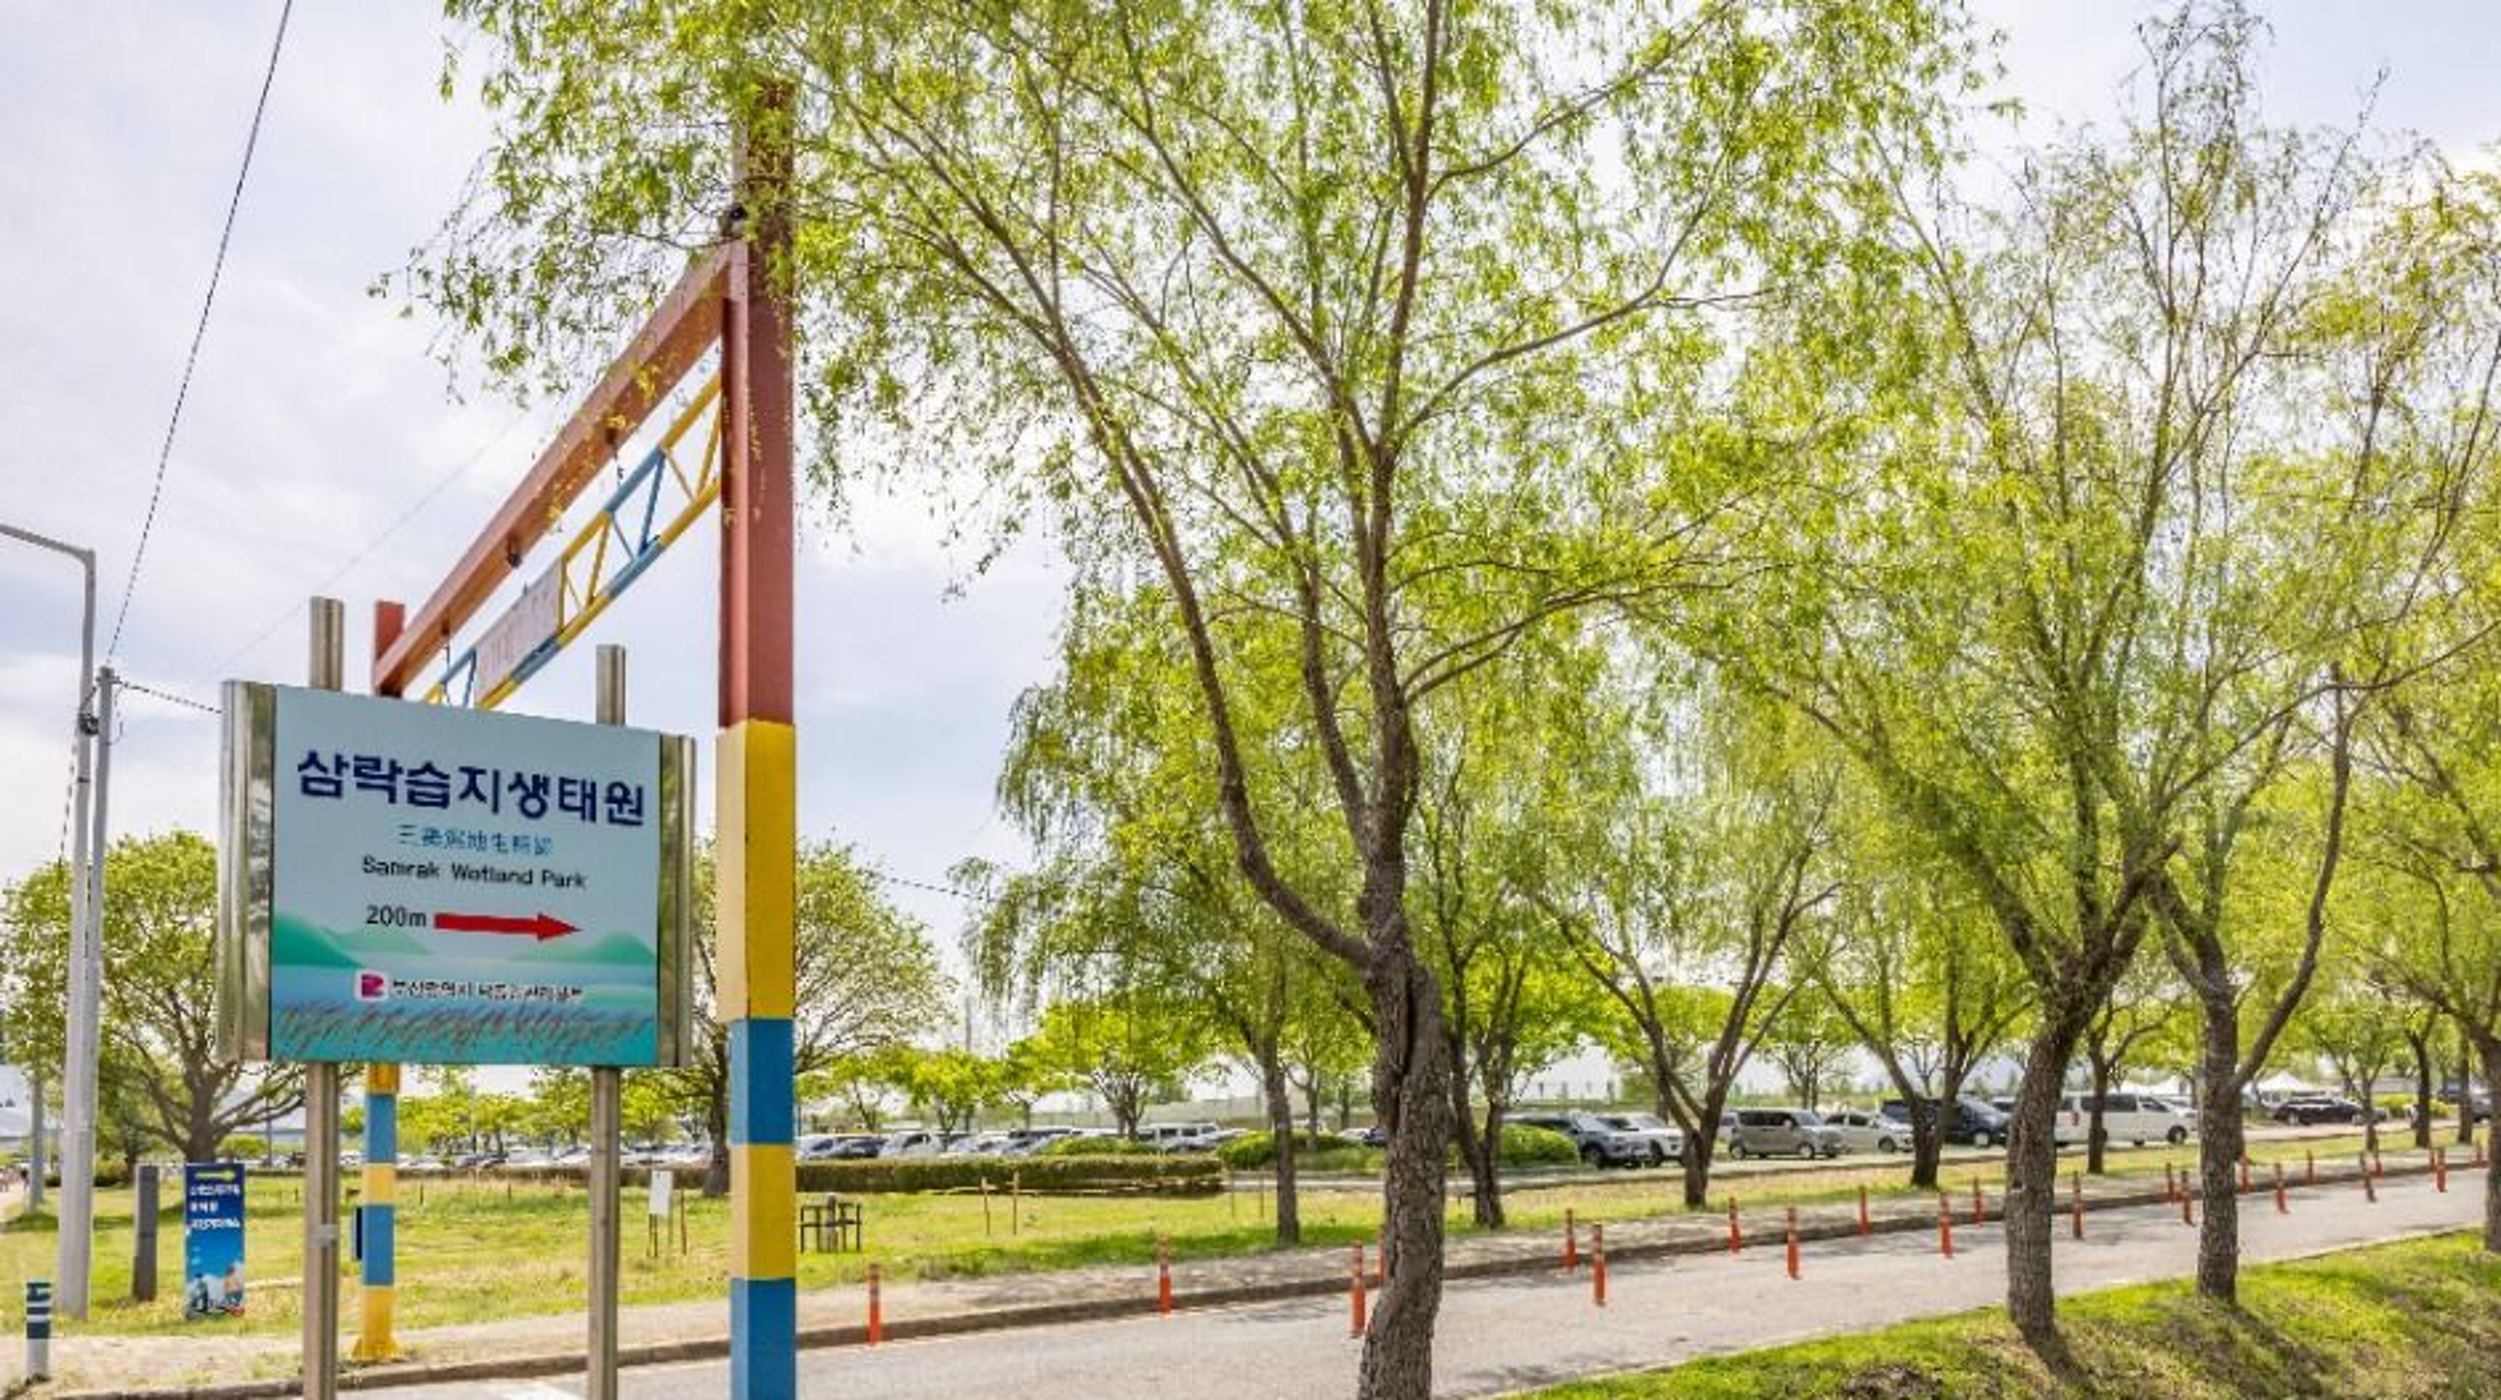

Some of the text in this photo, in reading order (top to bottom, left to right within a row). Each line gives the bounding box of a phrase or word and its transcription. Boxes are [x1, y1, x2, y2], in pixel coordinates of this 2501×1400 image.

[298, 751, 645, 827] 삼락습지생태원
[363, 855, 586, 888] Samrak Wetland Park
[366, 905, 427, 928] 200m
